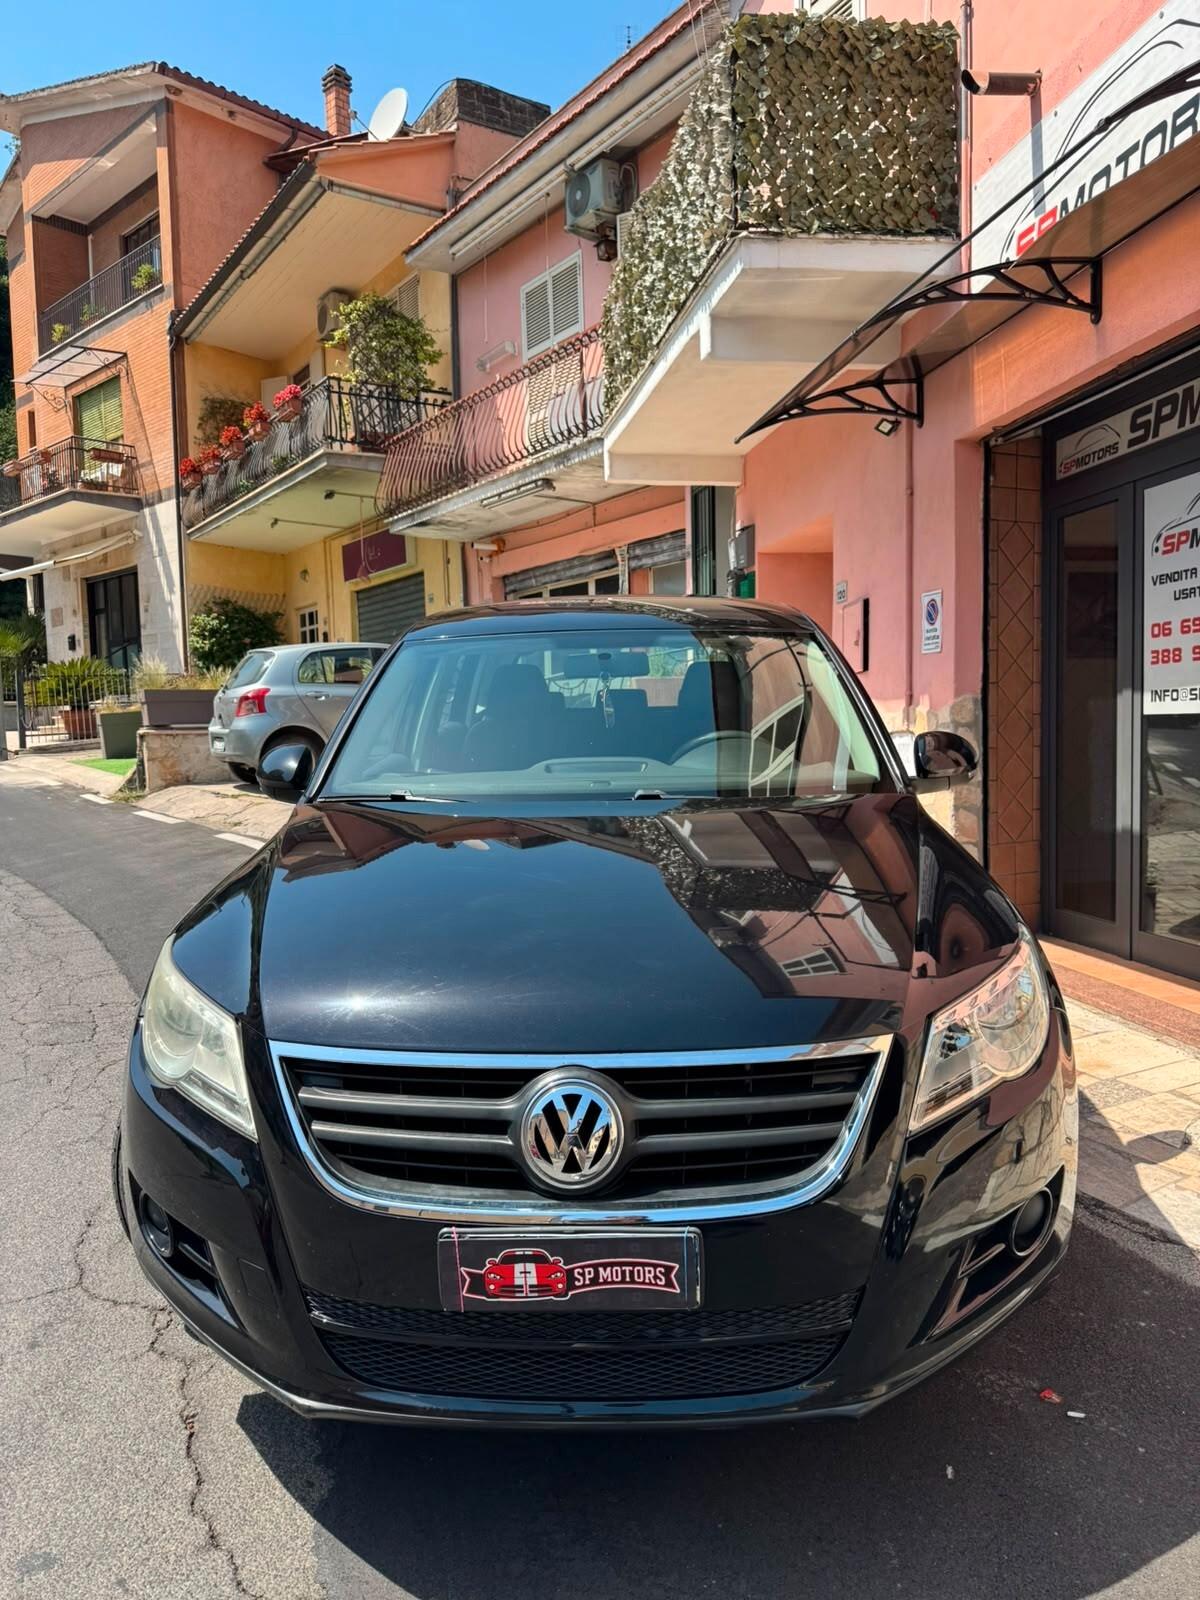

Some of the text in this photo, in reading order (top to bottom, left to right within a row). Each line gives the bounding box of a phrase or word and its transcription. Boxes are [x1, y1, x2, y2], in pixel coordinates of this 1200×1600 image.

[1061, 441, 1120, 474] SPMOTORS
[1151, 567, 1198, 586] VENDITA
[1151, 621, 1172, 638] 06
[1151, 647, 1182, 665] 388
[1151, 687, 1200, 703] INFO@S
[574, 1265, 666, 1286] SP MOTORS
